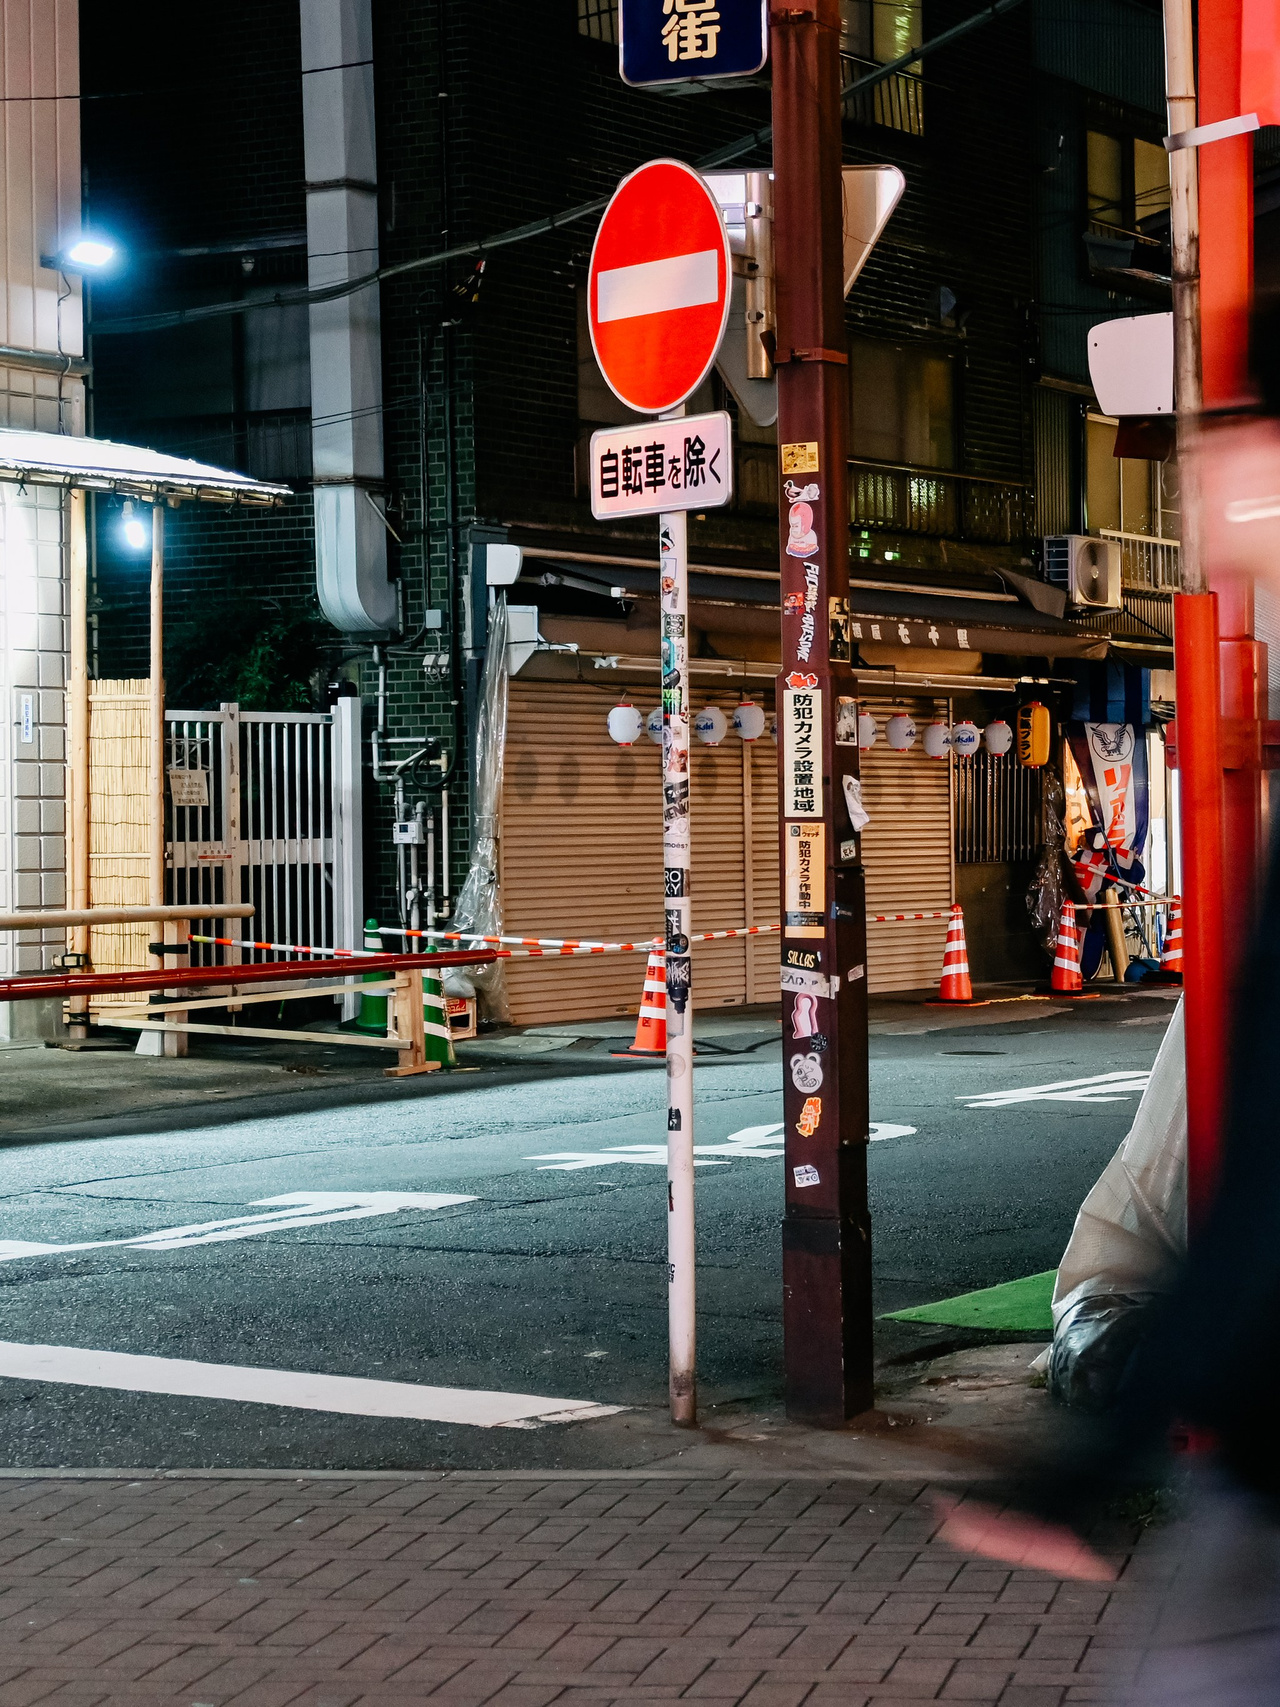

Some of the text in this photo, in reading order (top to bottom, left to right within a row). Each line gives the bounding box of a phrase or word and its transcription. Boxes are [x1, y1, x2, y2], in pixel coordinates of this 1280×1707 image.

[600, 434, 721, 499] 自転車を除く
[793, 694, 815, 813] 防犯カメラ設置地域
[798, 840, 812, 910] 防犯カメラ作動中
